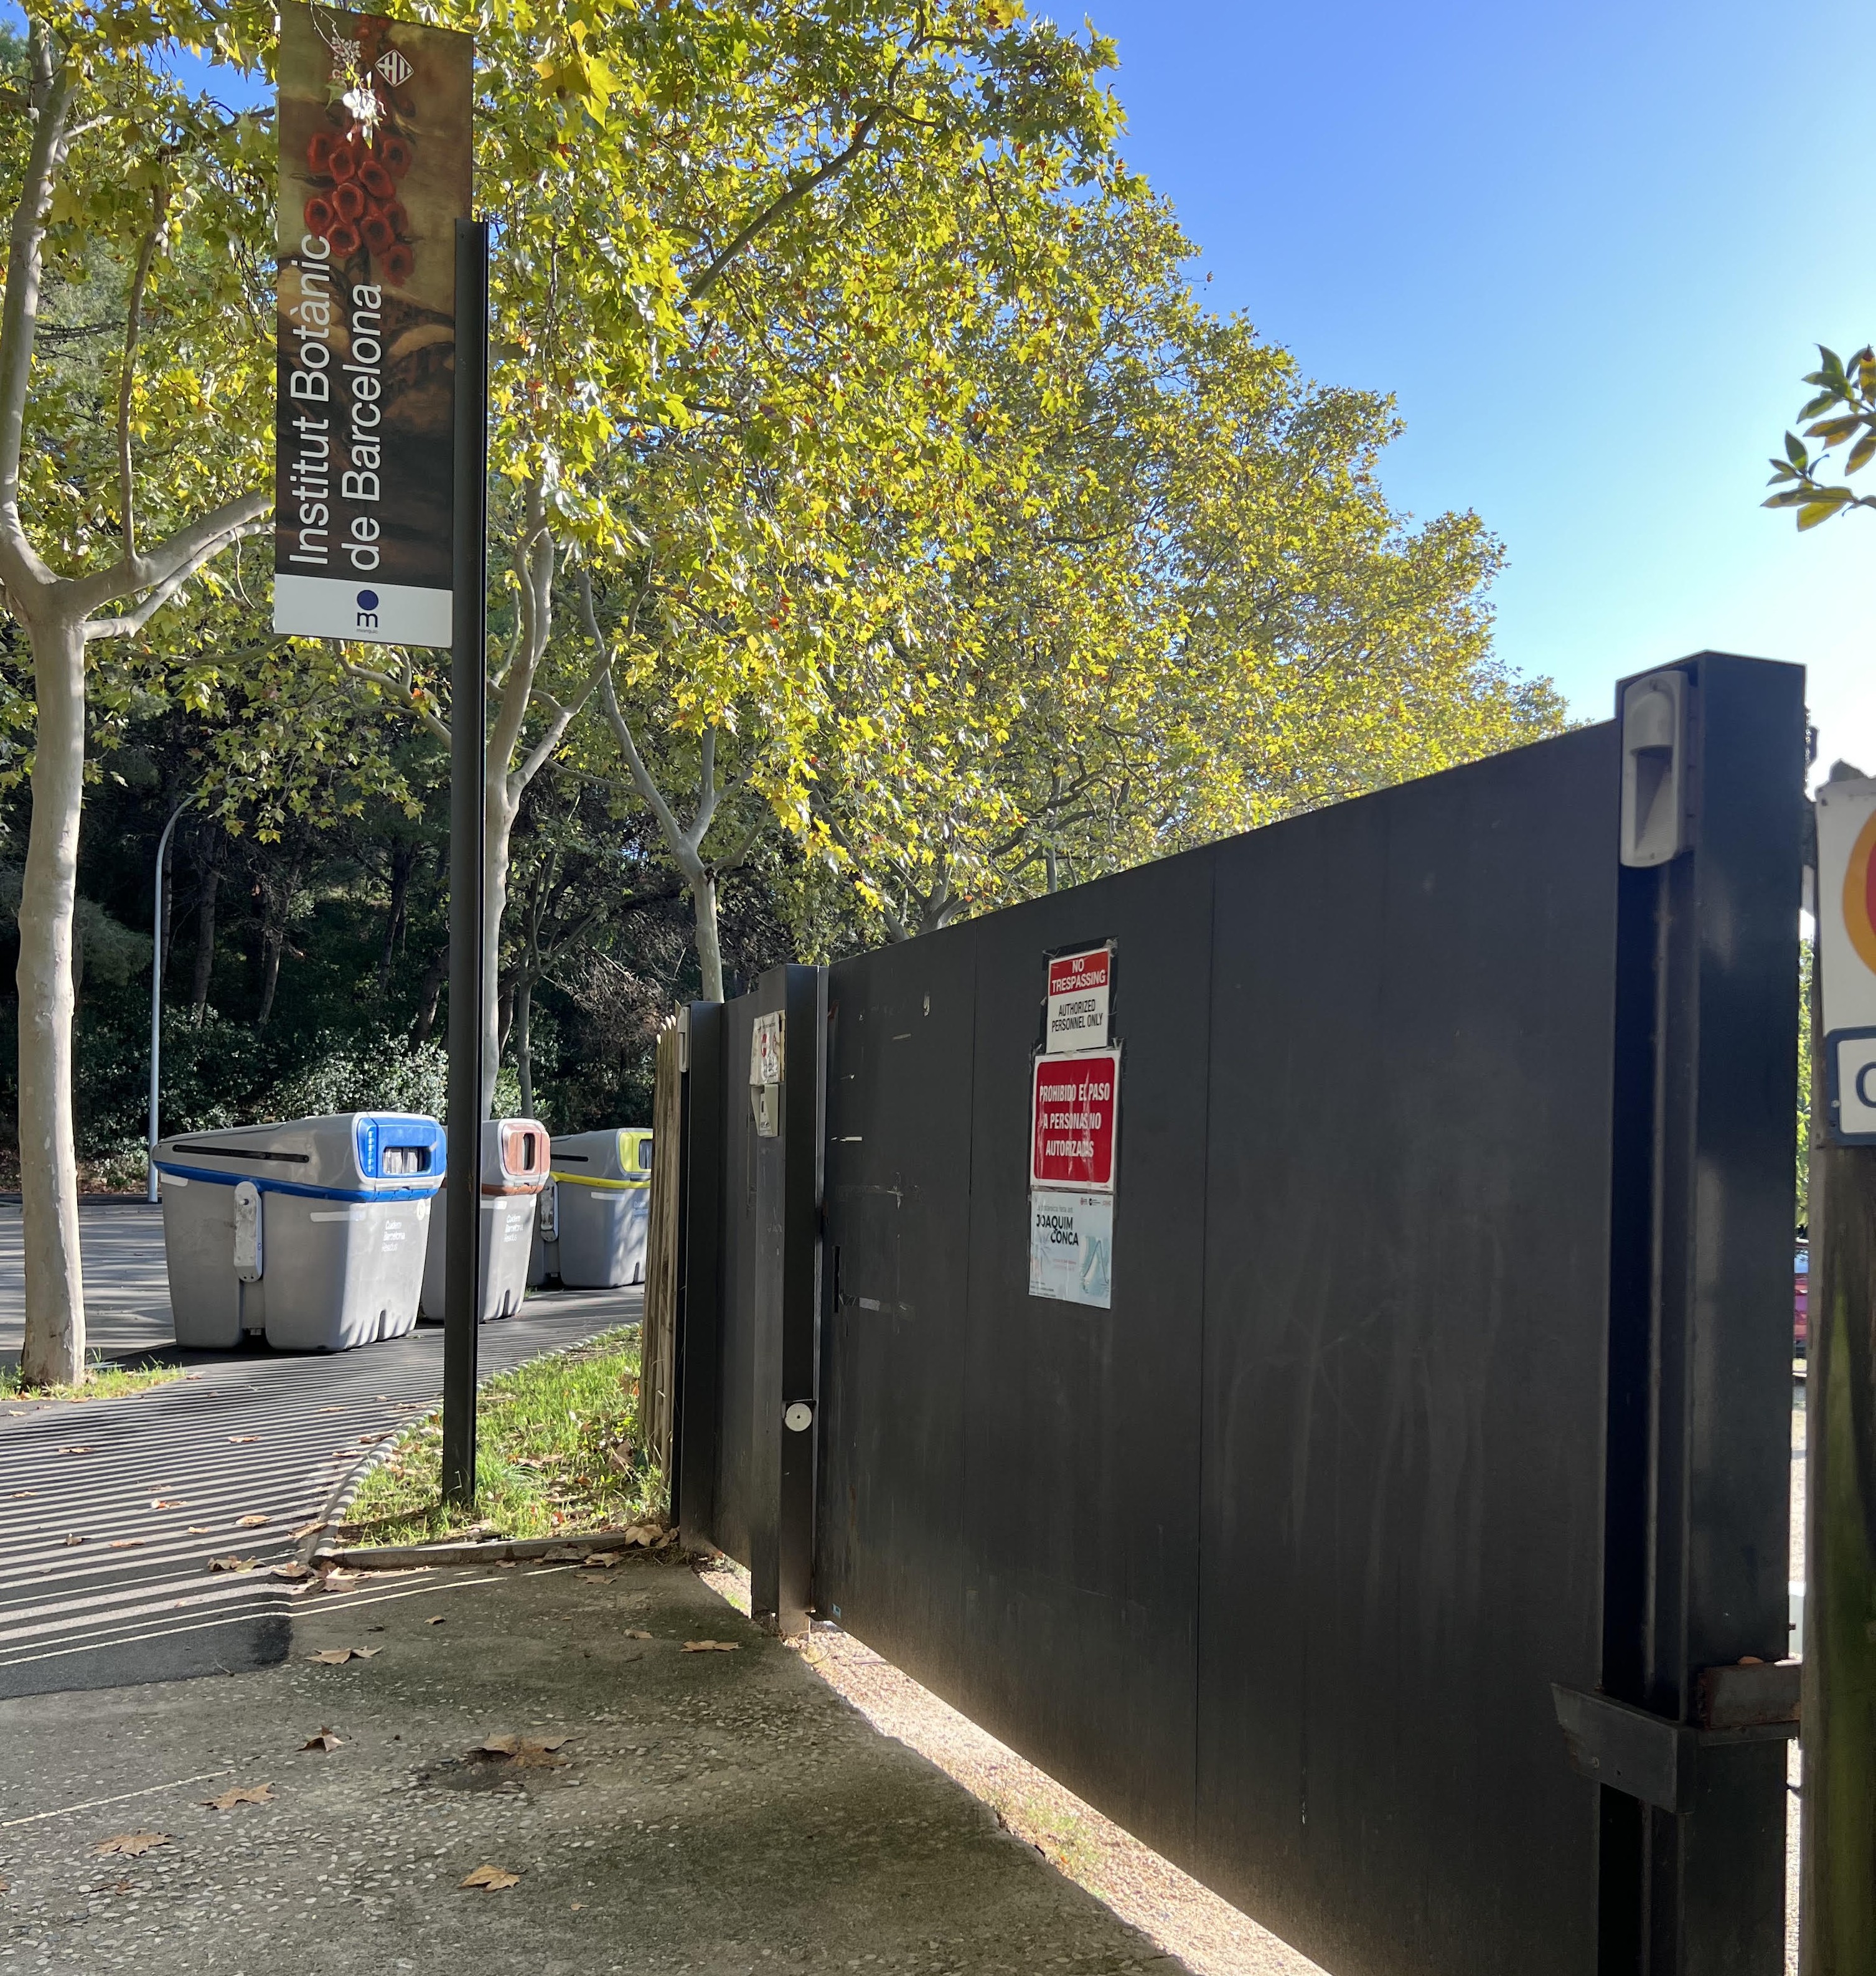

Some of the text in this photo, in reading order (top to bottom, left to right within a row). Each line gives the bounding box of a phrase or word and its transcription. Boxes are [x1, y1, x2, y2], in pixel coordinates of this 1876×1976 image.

[289, 235, 330, 564] Institut Botànic
[341, 284, 382, 571] de Barcelona
[1072, 959, 1084, 974] NO
[1052, 969, 1105, 993] TRESPASSING
[1058, 999, 1095, 1016] AUTHORIZED
[1051, 1013, 1103, 1032] PERSONNEL ONLY
[1039, 1083, 1110, 1101] PROHIBIDO EL PASO
[1043, 1112, 1101, 1130] A PERSONAS NO
[1036, 1214, 1073, 1231] JOAQUIM
[1051, 1231, 1079, 1246] CONCA
